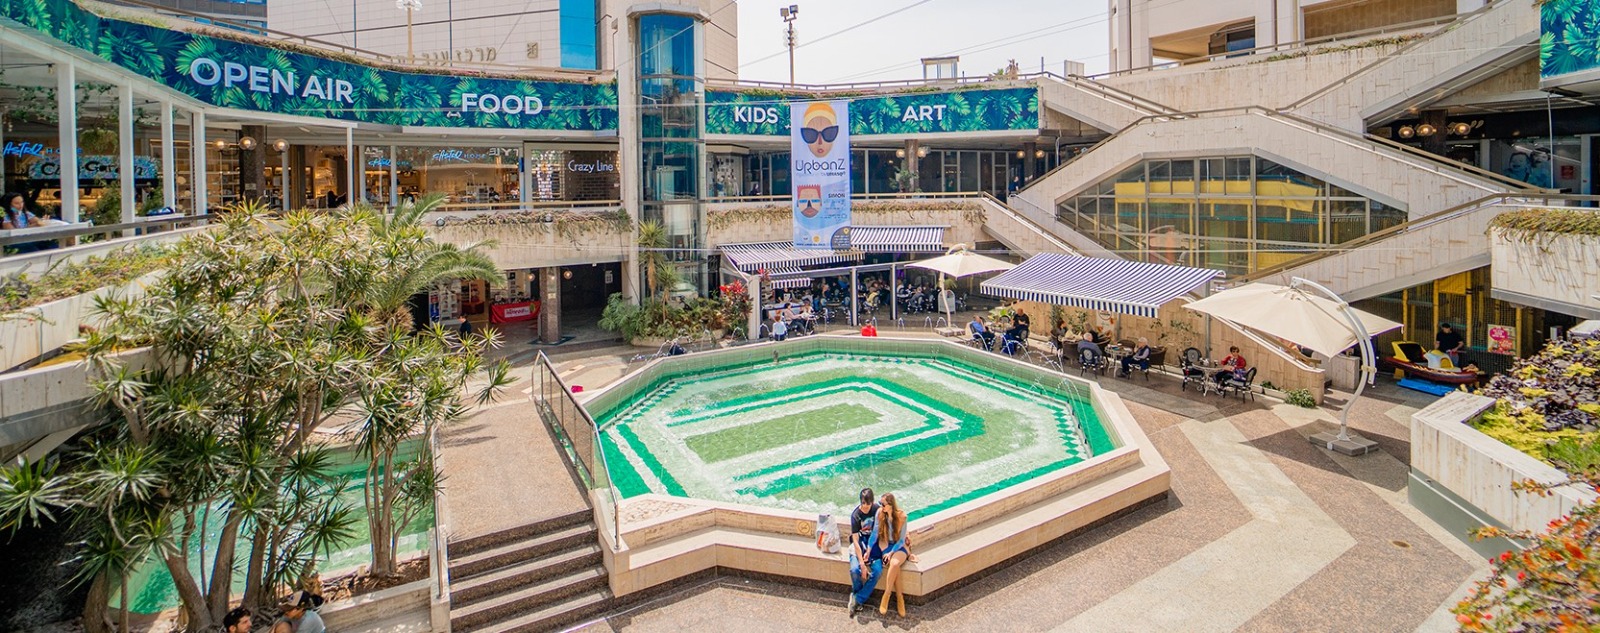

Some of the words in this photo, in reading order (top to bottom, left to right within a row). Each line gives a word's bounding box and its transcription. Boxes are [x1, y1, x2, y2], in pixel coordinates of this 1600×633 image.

[190, 58, 295, 96] OPEN
[302, 75, 354, 104] AIR
[462, 93, 543, 114] FOOD
[734, 106, 778, 124] KIDS
[902, 104, 947, 122] ART
[46, 147, 83, 155] HOE
[568, 160, 595, 173] Crazy
[597, 160, 613, 171] Line
